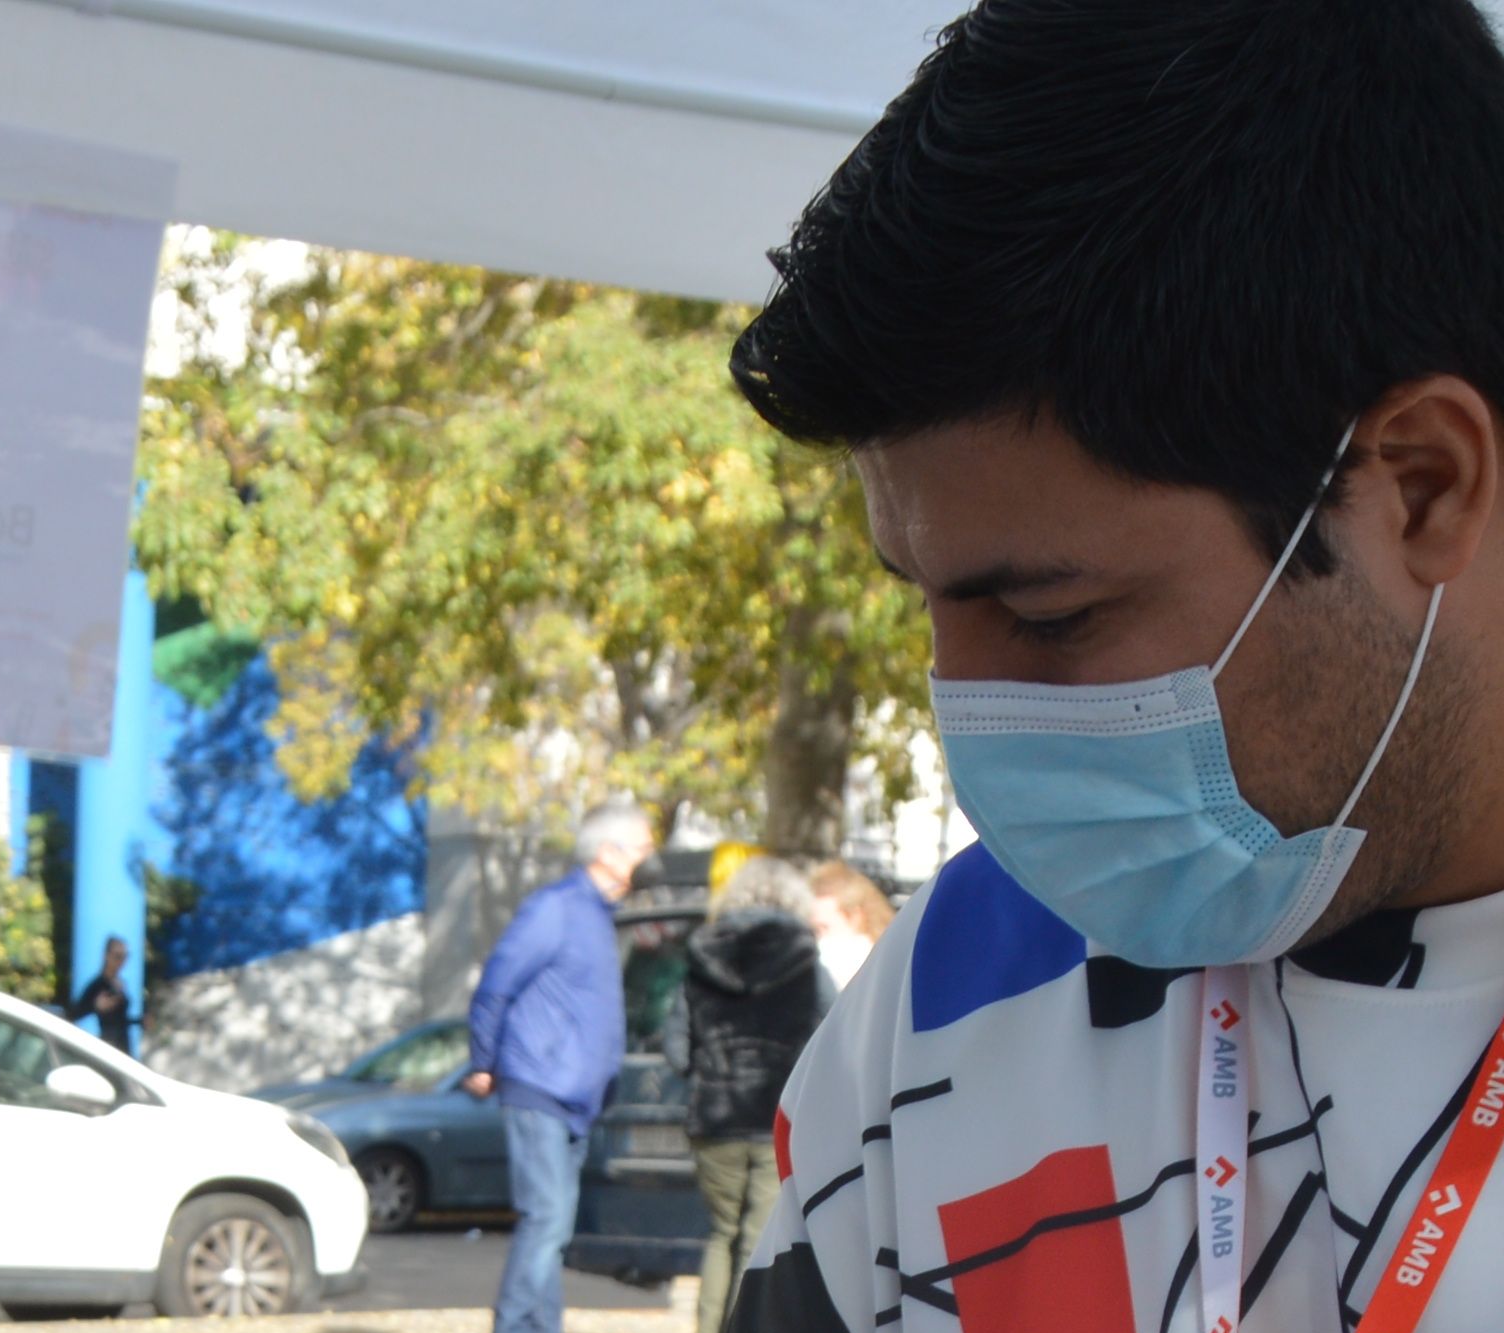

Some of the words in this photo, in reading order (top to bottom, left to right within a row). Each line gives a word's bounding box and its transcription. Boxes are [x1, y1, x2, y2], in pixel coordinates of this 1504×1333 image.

[1212, 1036, 1237, 1099] AMB
[1210, 1195, 1234, 1260] AMB
[1395, 1218, 1444, 1287] AMB
